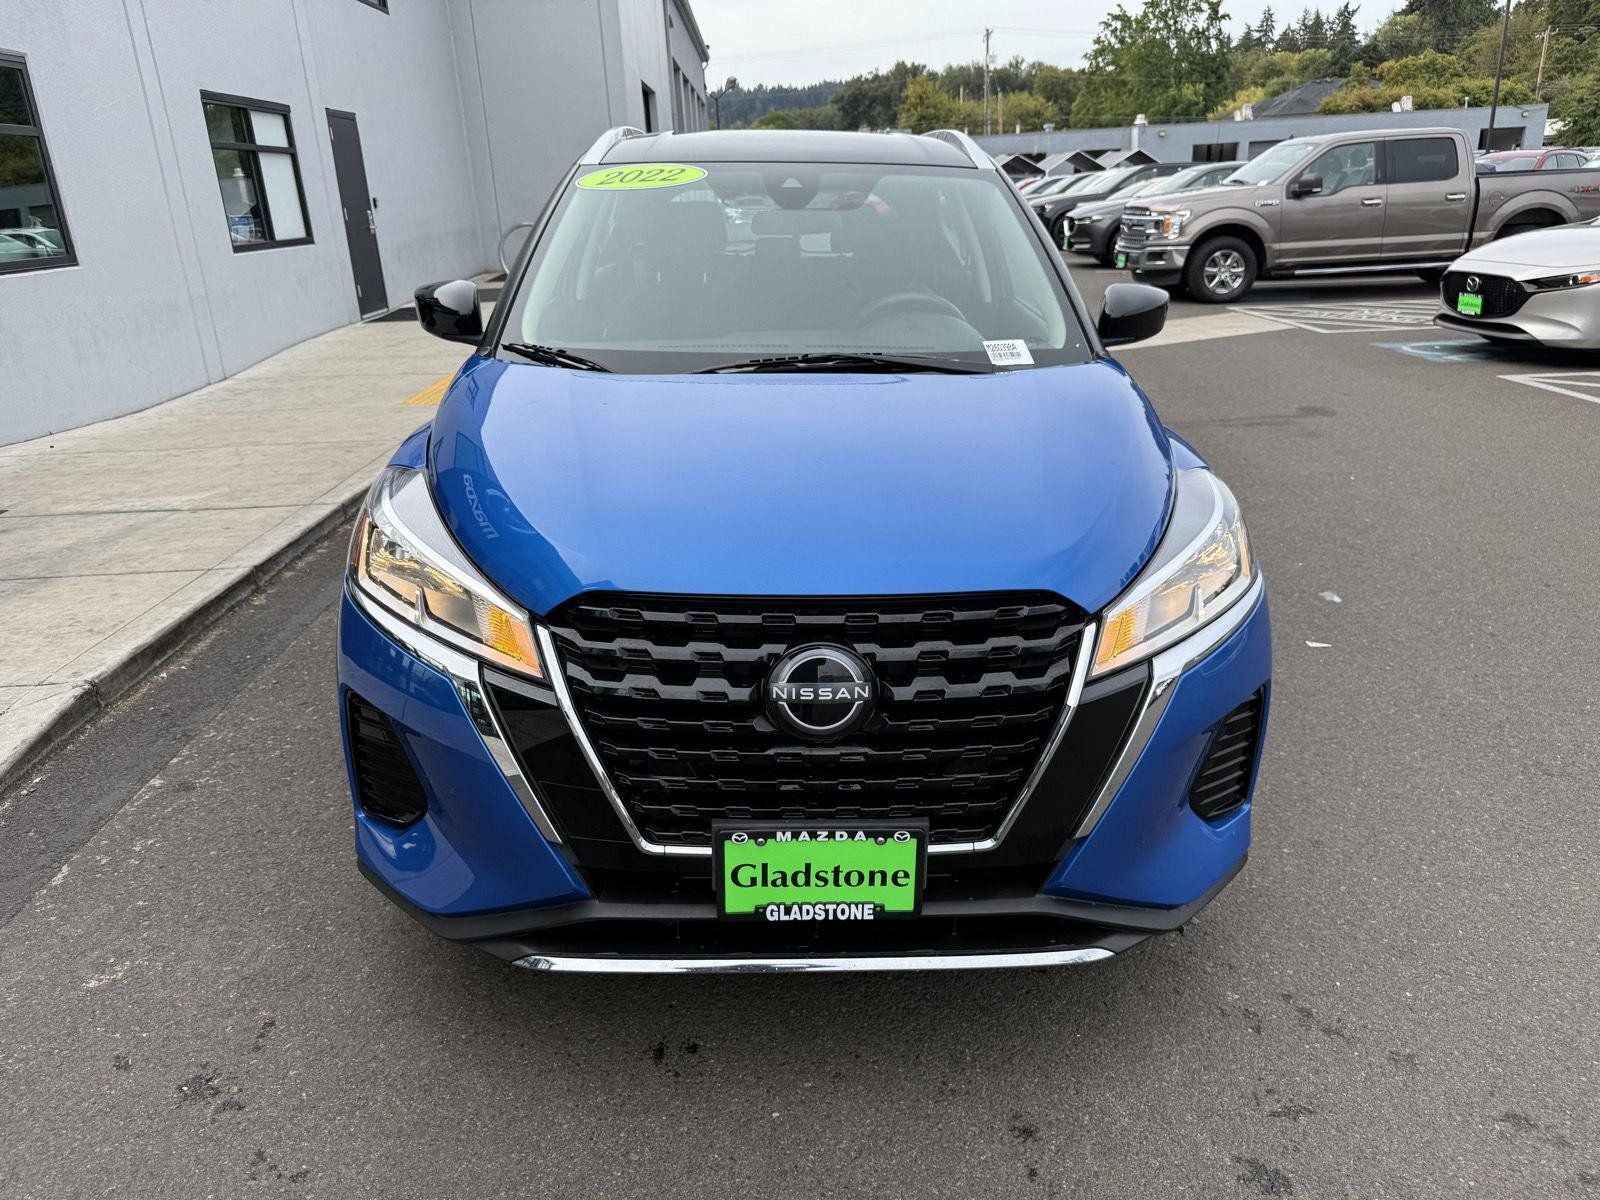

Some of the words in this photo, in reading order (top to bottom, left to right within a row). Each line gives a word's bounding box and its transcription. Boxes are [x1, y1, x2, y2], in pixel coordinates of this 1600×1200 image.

[597, 168, 686, 186] 2022
[772, 685, 869, 700] NISSAN
[776, 831, 867, 842] MAZDA
[730, 862, 910, 888] Gladstone
[766, 904, 875, 922] GLADSTONE
